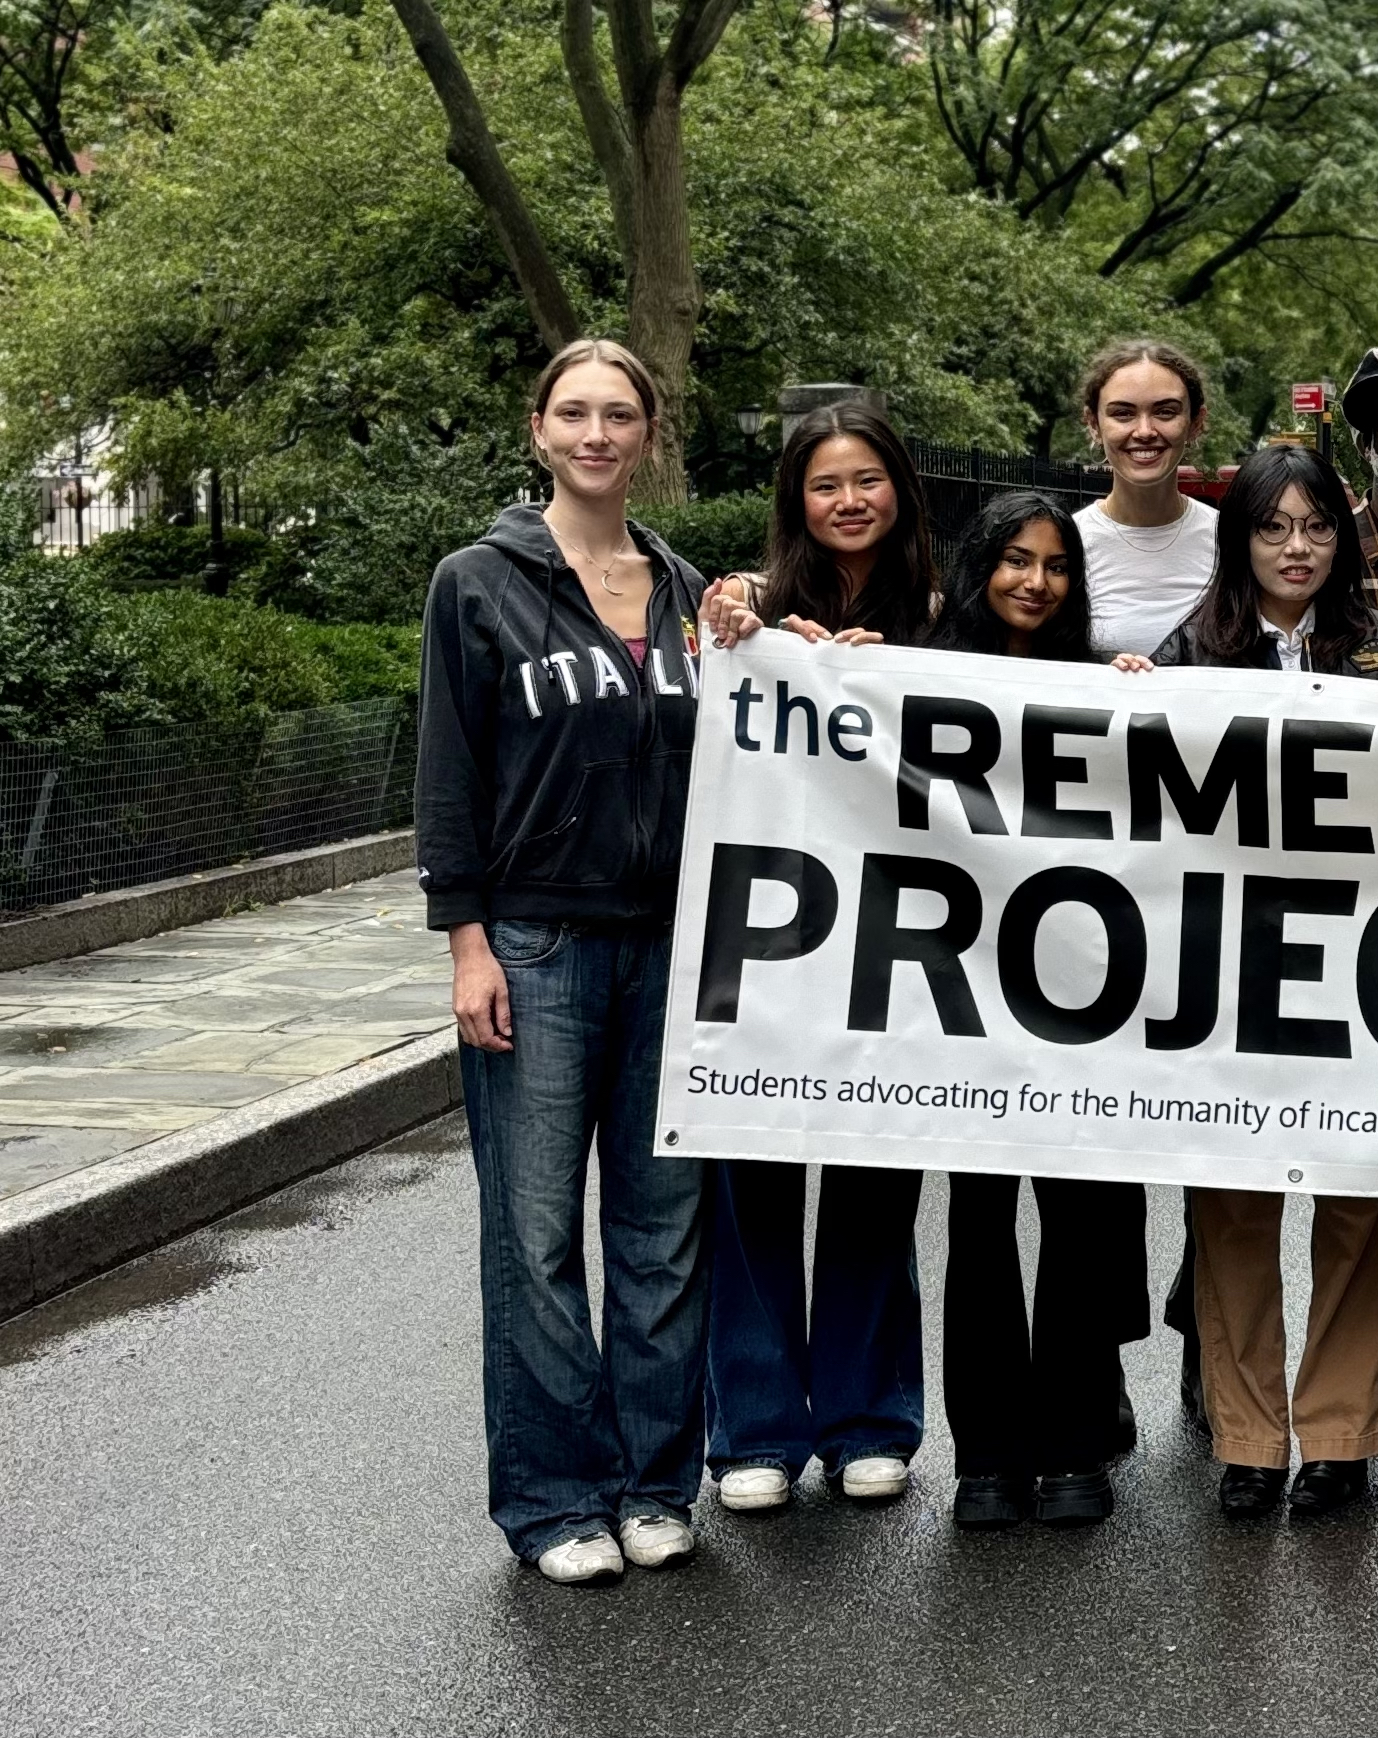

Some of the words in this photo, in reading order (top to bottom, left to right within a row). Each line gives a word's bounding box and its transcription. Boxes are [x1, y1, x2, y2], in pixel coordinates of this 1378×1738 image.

[729, 677, 873, 762] the
[688, 1066, 827, 1100] Students
[837, 1075, 1009, 1118] advocating
[1019, 1084, 1062, 1113] for
[1070, 1088, 1119, 1117] the
[1129, 1090, 1271, 1134] humanity
[1279, 1101, 1312, 1128] of
